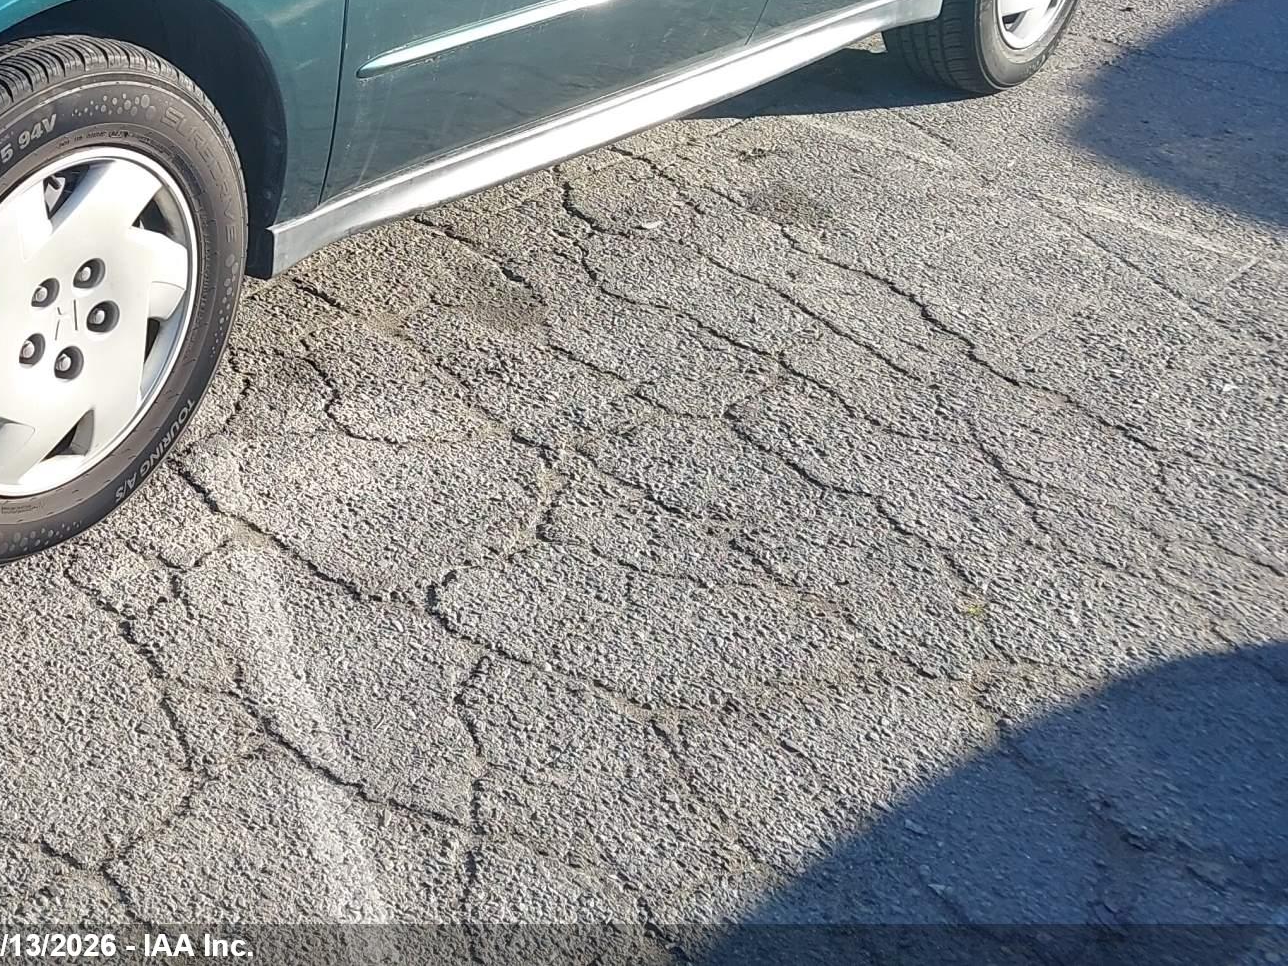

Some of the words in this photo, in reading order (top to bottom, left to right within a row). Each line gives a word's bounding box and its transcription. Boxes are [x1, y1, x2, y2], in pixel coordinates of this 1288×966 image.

[18, 113, 57, 150] 94V
[140, 399, 195, 477] TOURING
[115, 472, 138, 503] A/S
